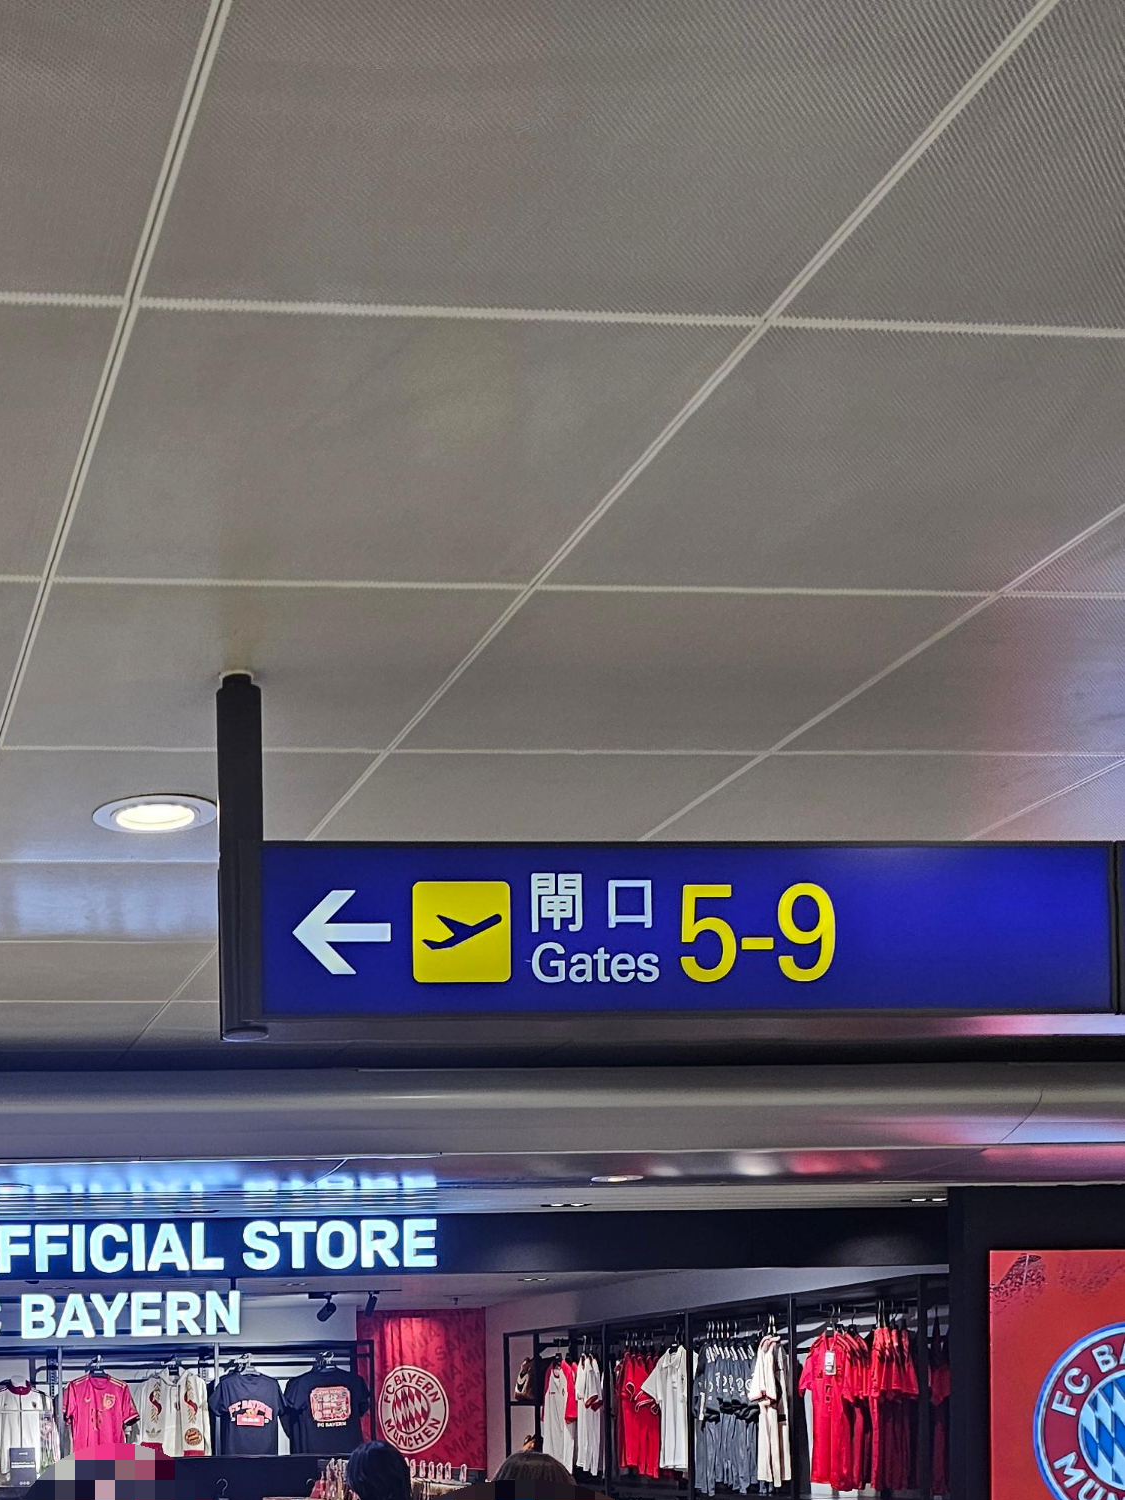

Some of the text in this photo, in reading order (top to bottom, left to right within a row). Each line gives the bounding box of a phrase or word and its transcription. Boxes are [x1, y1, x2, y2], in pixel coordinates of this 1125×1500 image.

[530, 872, 653, 933] 閘口
[679, 882, 836, 983] 5-9
[530, 941, 660, 983] Gates
[242, 1218, 438, 1271] STORE
[20, 1290, 241, 1340] BAYERN
[383, 1384, 395, 1404] FC
[395, 1372, 441, 1403] BAYERN
[1051, 1367, 1091, 1417] FC
